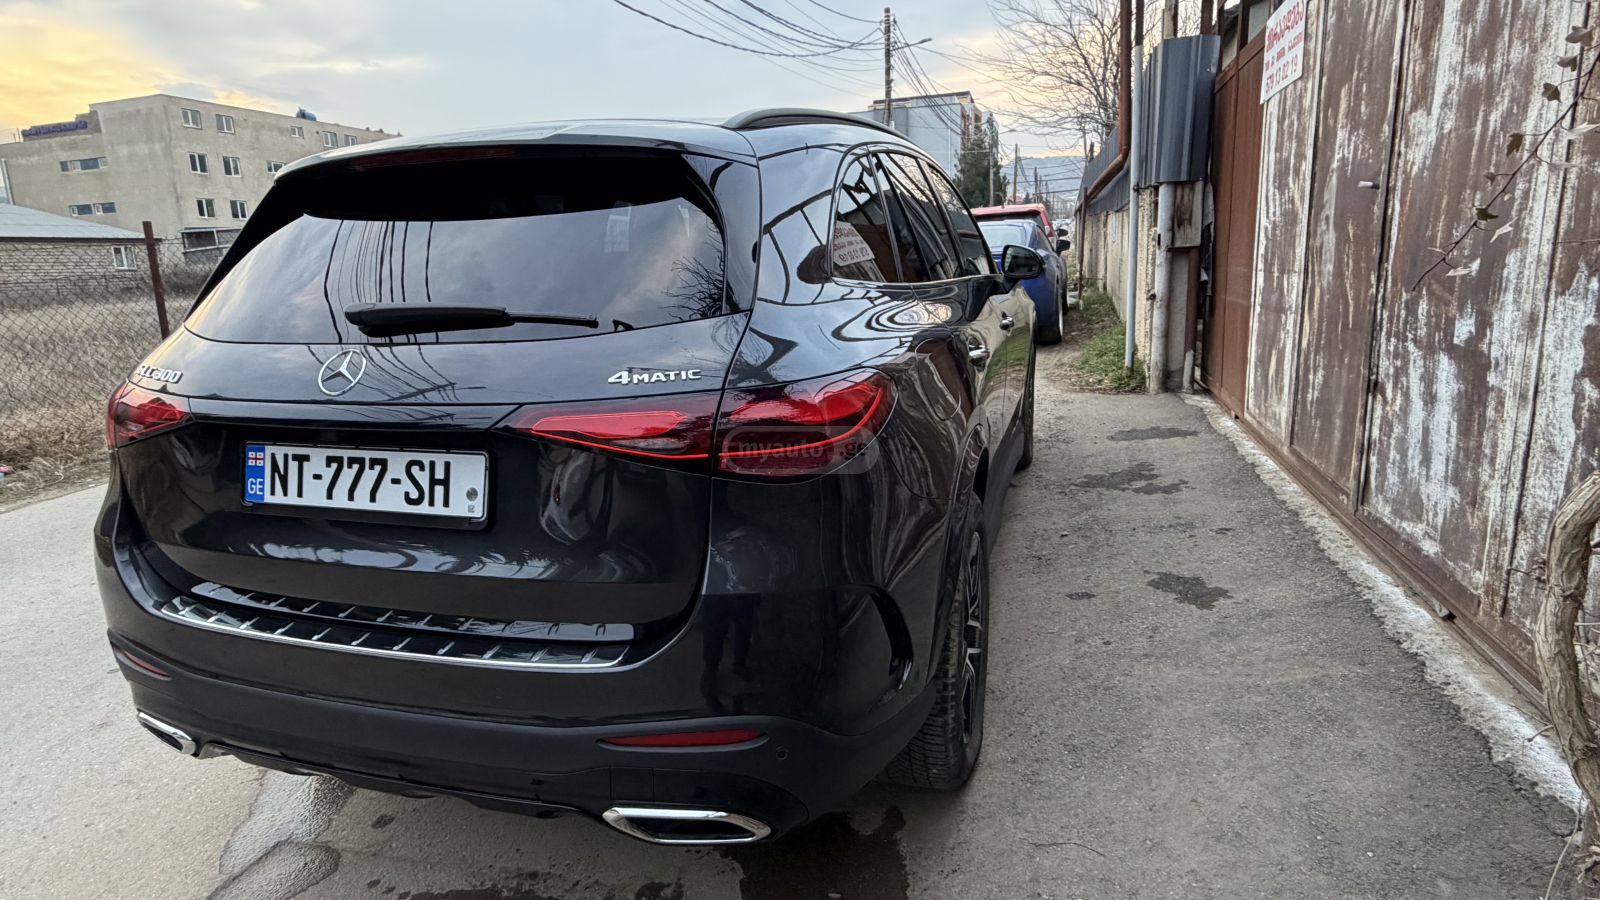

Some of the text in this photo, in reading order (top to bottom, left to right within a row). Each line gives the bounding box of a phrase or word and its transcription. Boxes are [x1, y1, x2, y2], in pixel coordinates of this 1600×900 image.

[607, 369, 702, 385] 4MATIC
[247, 478, 264, 495] GE
[270, 452, 451, 508] NT-777-SH
